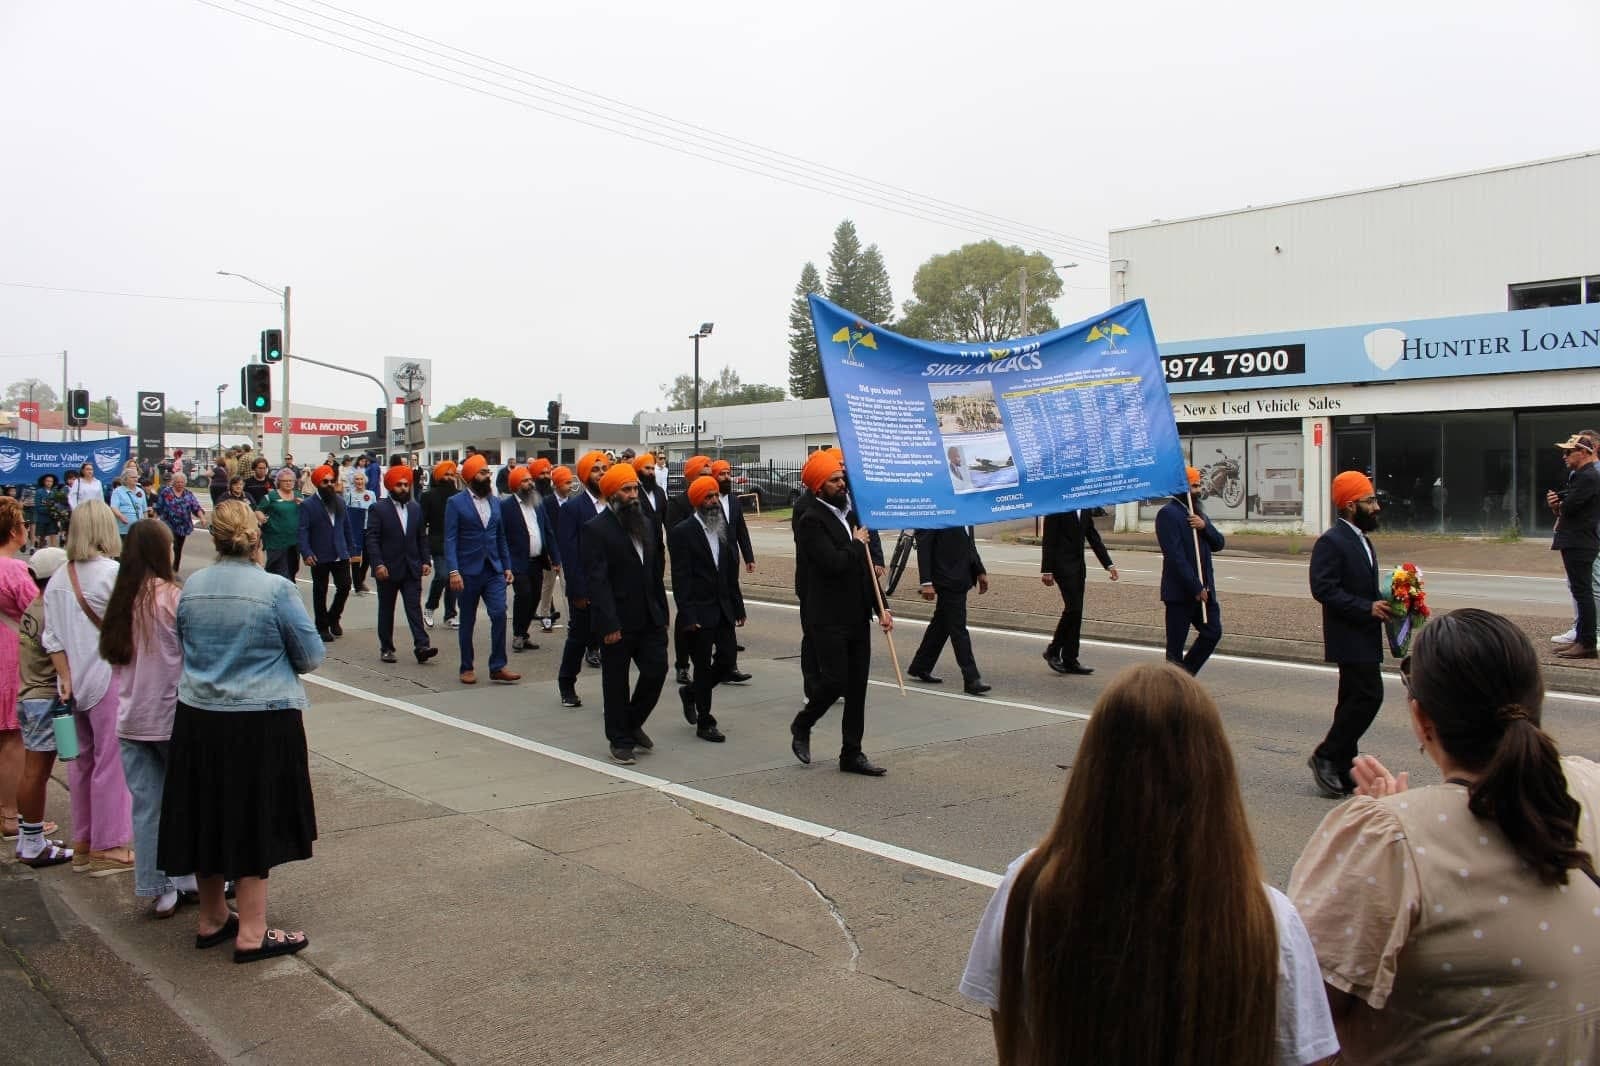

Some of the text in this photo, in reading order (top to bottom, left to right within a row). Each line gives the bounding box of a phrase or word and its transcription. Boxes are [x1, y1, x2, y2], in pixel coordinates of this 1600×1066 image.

[921, 362, 968, 377] SIKH
[969, 351, 1043, 375] ANZACS
[1223, 350, 1289, 376] 7900
[1183, 396, 1341, 416] New & Used Vehicle Sales
[300, 421, 317, 431] KIA
[319, 422, 359, 432] MOTORS
[26, 452, 88, 462] Hunter Valley
